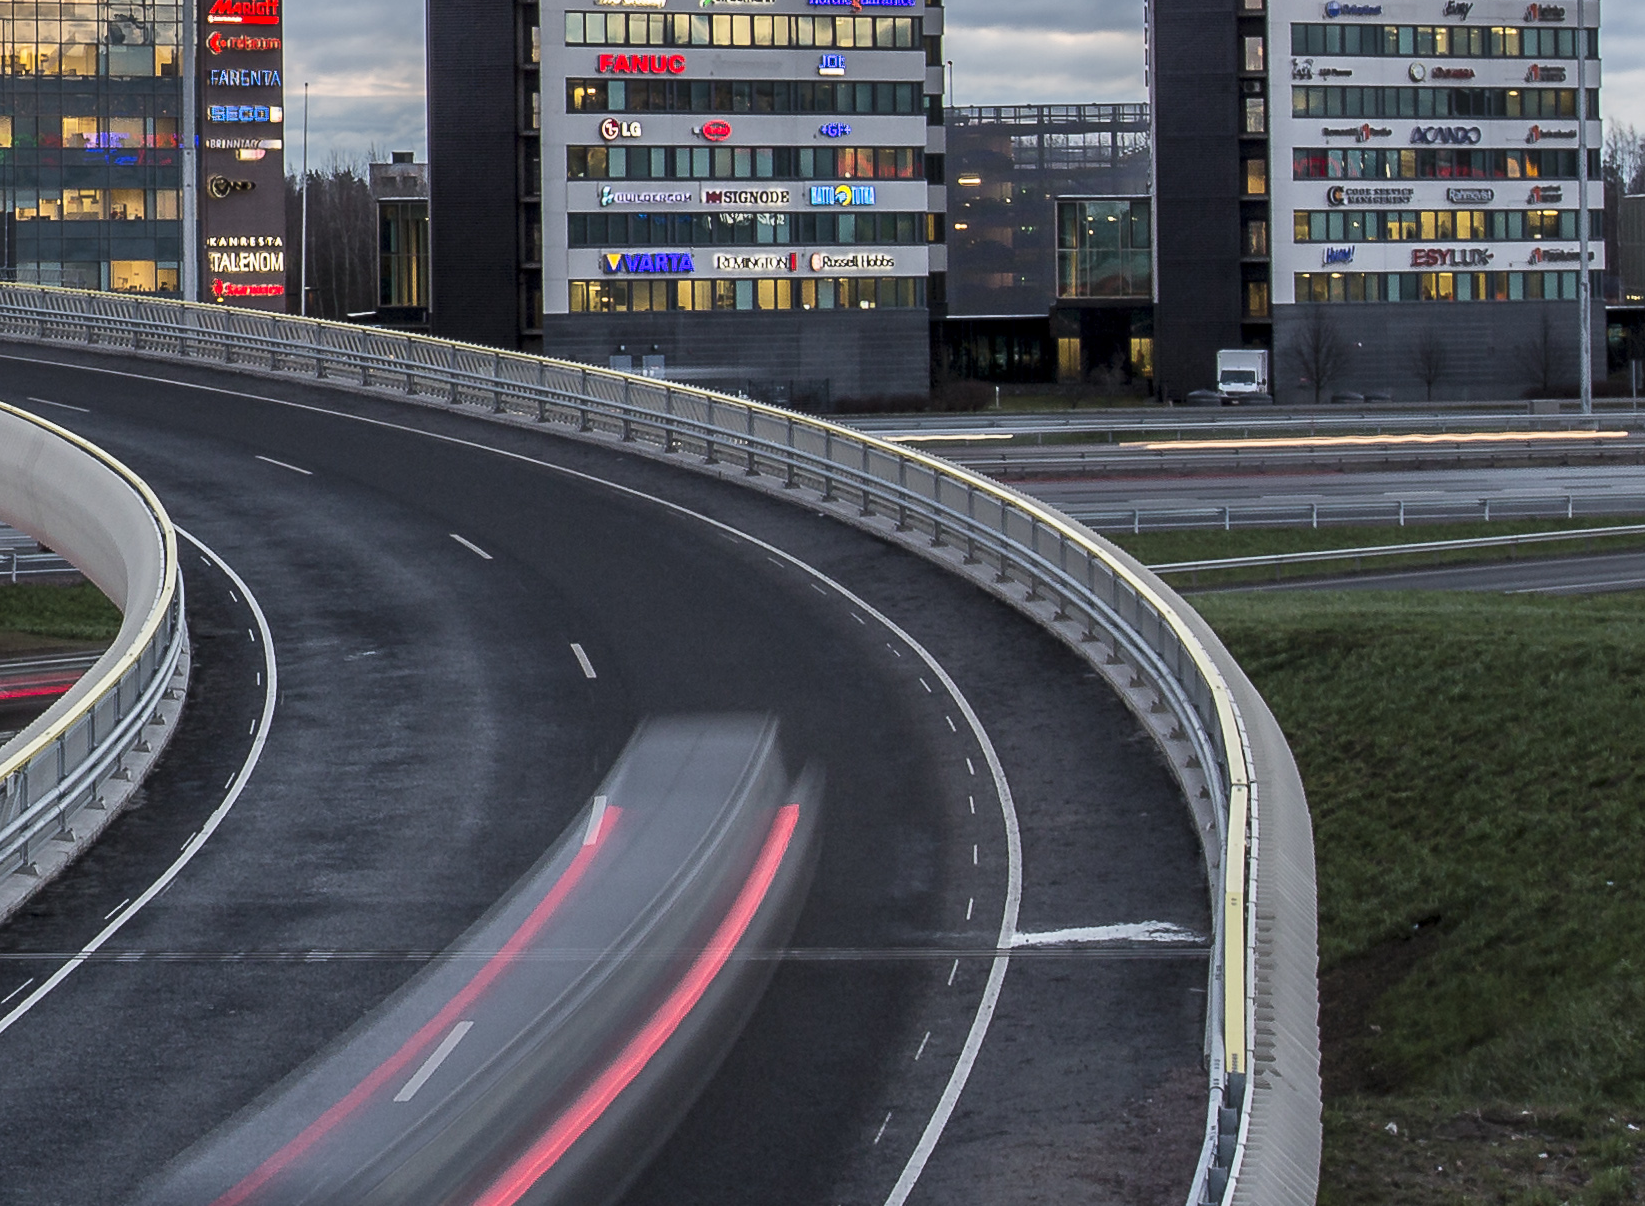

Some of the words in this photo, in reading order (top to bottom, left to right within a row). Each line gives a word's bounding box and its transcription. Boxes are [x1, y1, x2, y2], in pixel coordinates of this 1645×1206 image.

[598, 53, 687, 74] FANUC
[210, 69, 282, 86] FARENTA
[210, 105, 270, 122] SECO
[621, 121, 642, 137] LG
[1410, 126, 1481, 144] ACANDO
[723, 190, 790, 204] SIGNODE
[210, 236, 283, 247] KANRESTA
[210, 252, 284, 272] TALENOM
[623, 253, 695, 273] VARTA
[822, 255, 859, 267] Russell
[861, 255, 895, 267] Hobbs
[1412, 248, 1490, 266] ESYLUX
